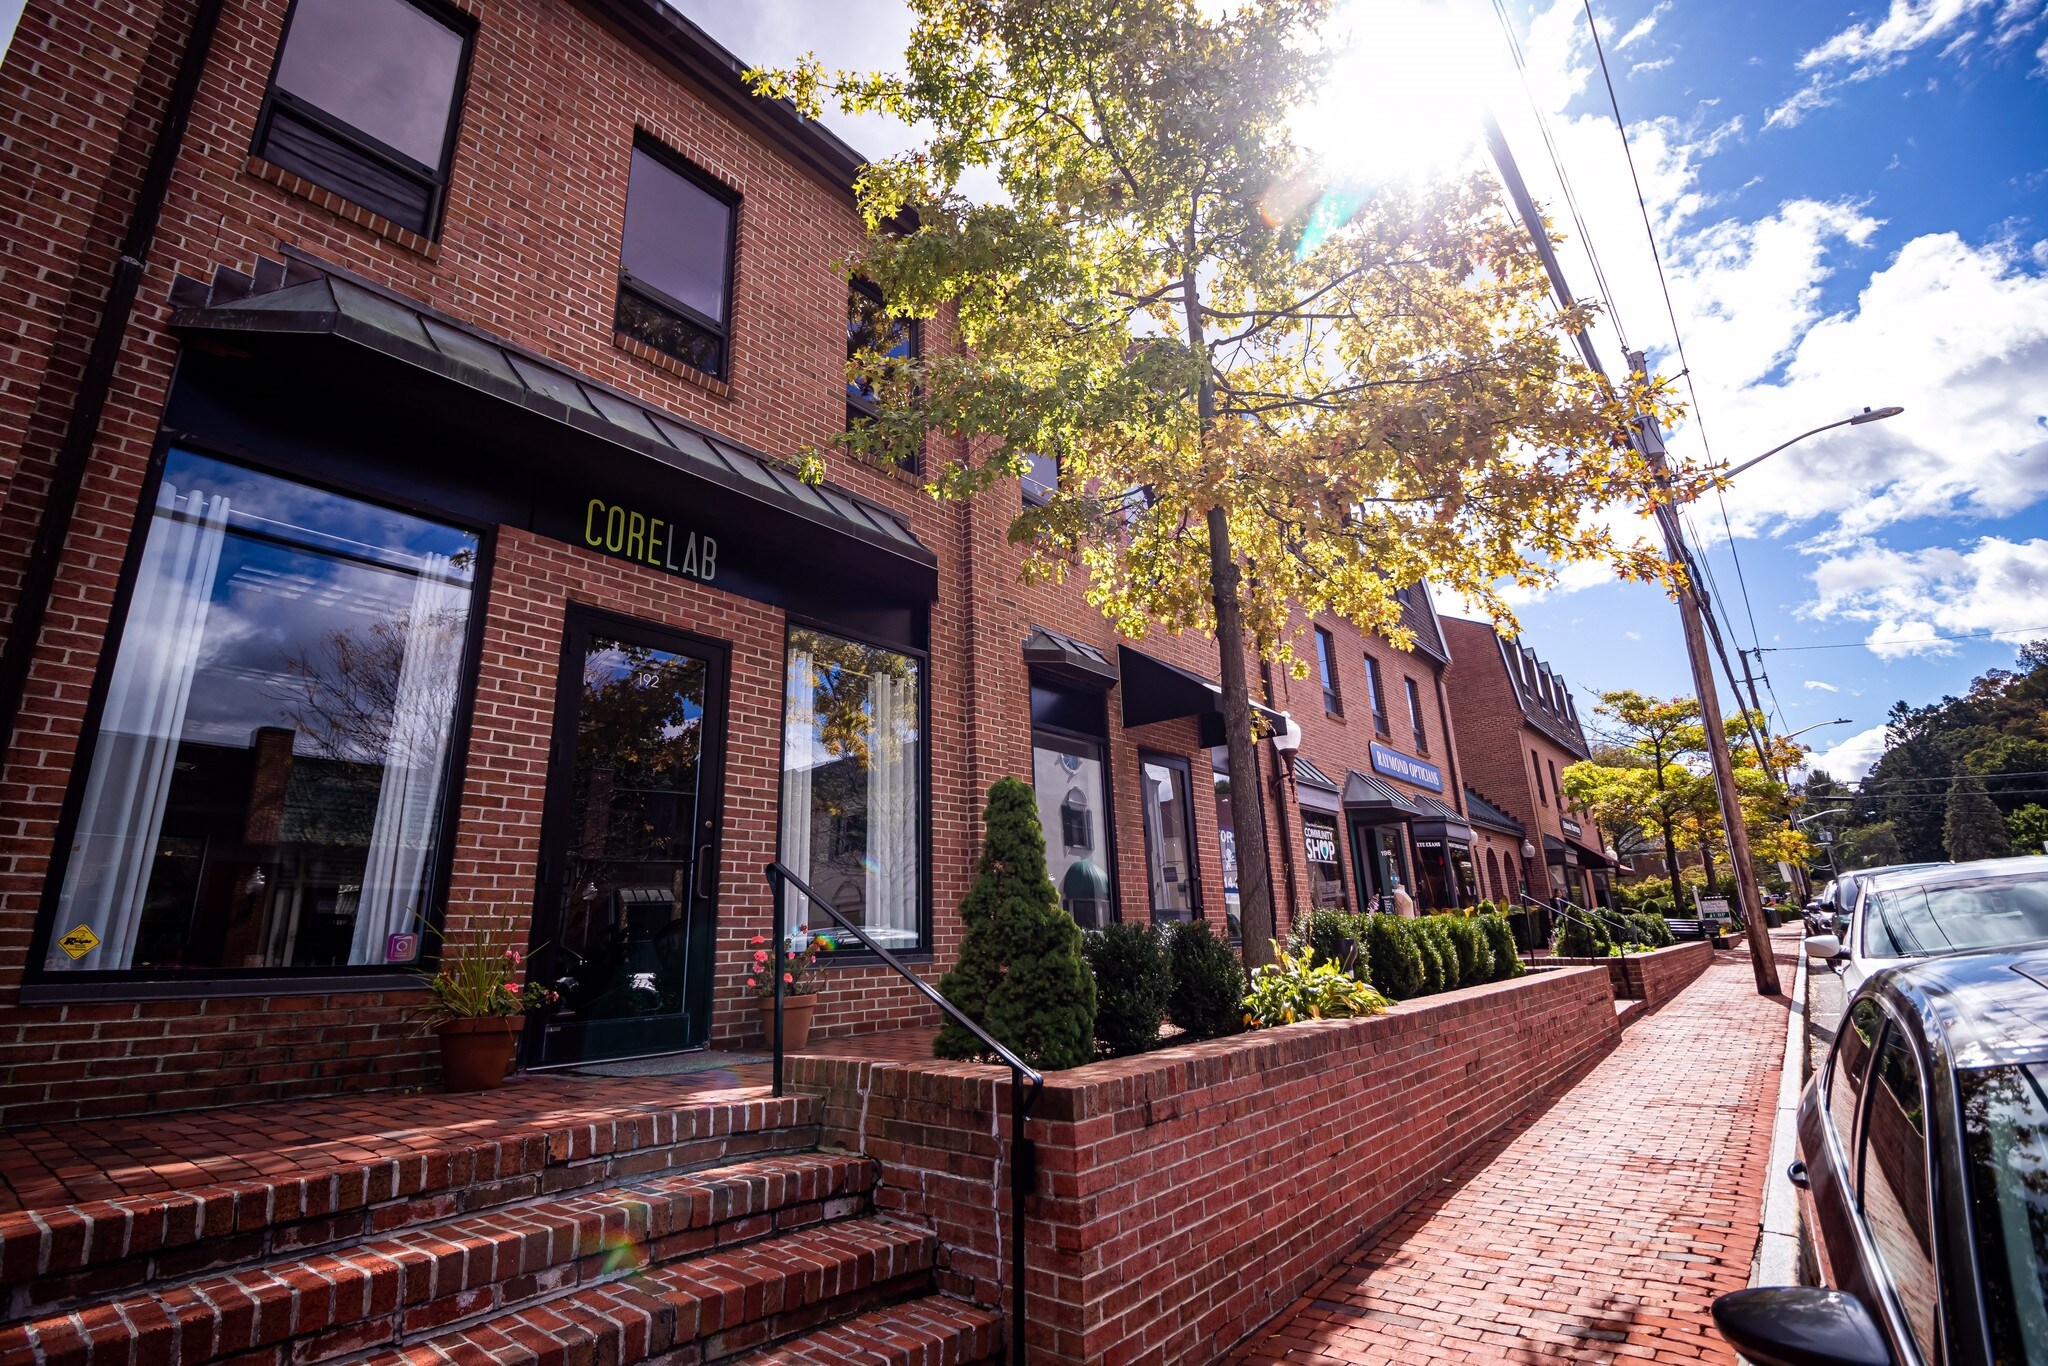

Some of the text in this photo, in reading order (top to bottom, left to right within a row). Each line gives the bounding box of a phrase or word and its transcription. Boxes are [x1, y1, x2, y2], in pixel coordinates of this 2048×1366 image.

[585, 499, 717, 580] CORELAB
[638, 672, 660, 688] 192
[1376, 750, 1439, 786] RAYMOND OPTICIANS
[1304, 827, 1333, 841] COMMUNITY
[1306, 838, 1335, 861] SHOP
